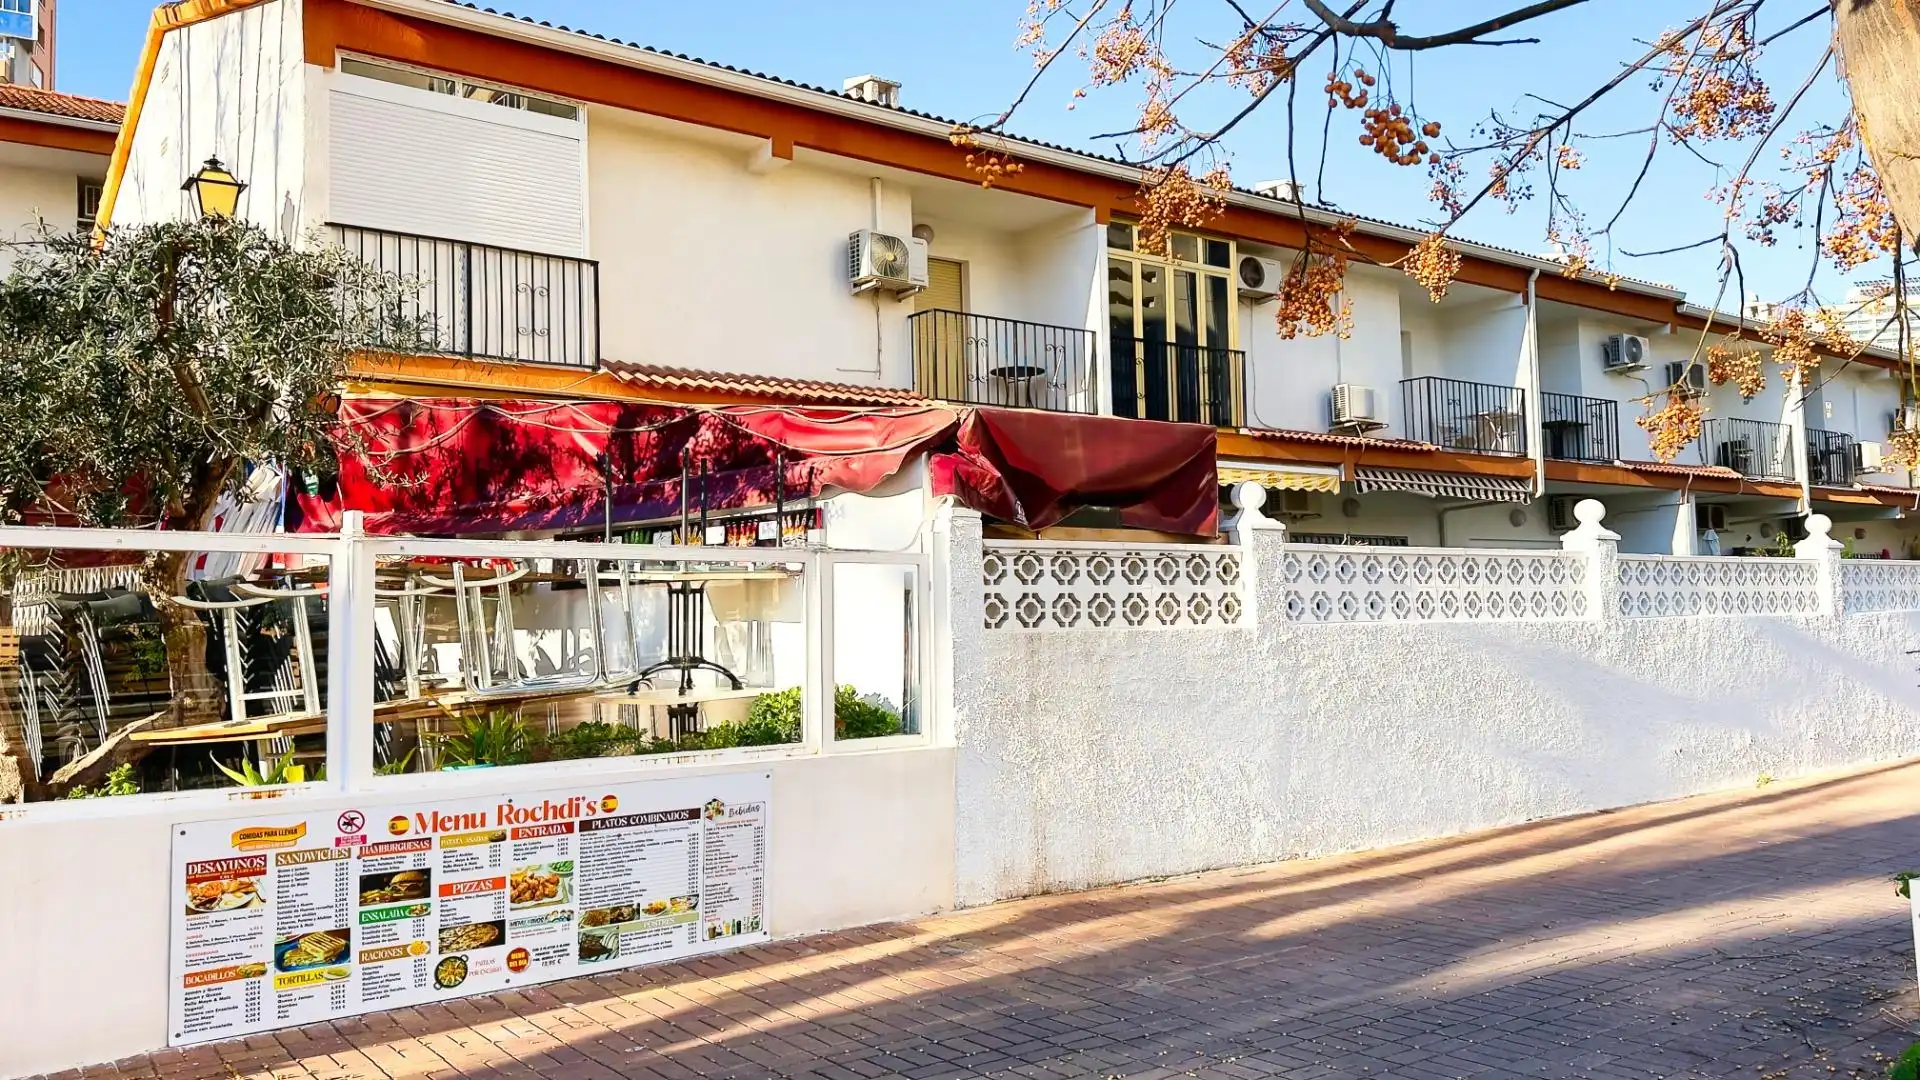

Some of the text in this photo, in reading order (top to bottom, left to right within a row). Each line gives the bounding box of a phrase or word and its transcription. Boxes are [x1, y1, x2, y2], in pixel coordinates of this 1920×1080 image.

[415, 796, 597, 835] Menu Rochdi's
[592, 810, 689, 830] PLATOS COMBINADOS
[239, 831, 263, 840] COMIDAS
[518, 824, 567, 838] ENTRADA
[362, 840, 430, 855] HAMBURGUESAS
[277, 849, 349, 865] SANDWICHES
[188, 856, 266, 875] DESAYUNOS
[452, 880, 493, 895] PIZZAS
[361, 909, 405, 922] ENSALADA
[362, 947, 403, 962] RACIONES
[185, 970, 236, 985] BOCADILLOS
[277, 971, 325, 986] TORTILLAS
